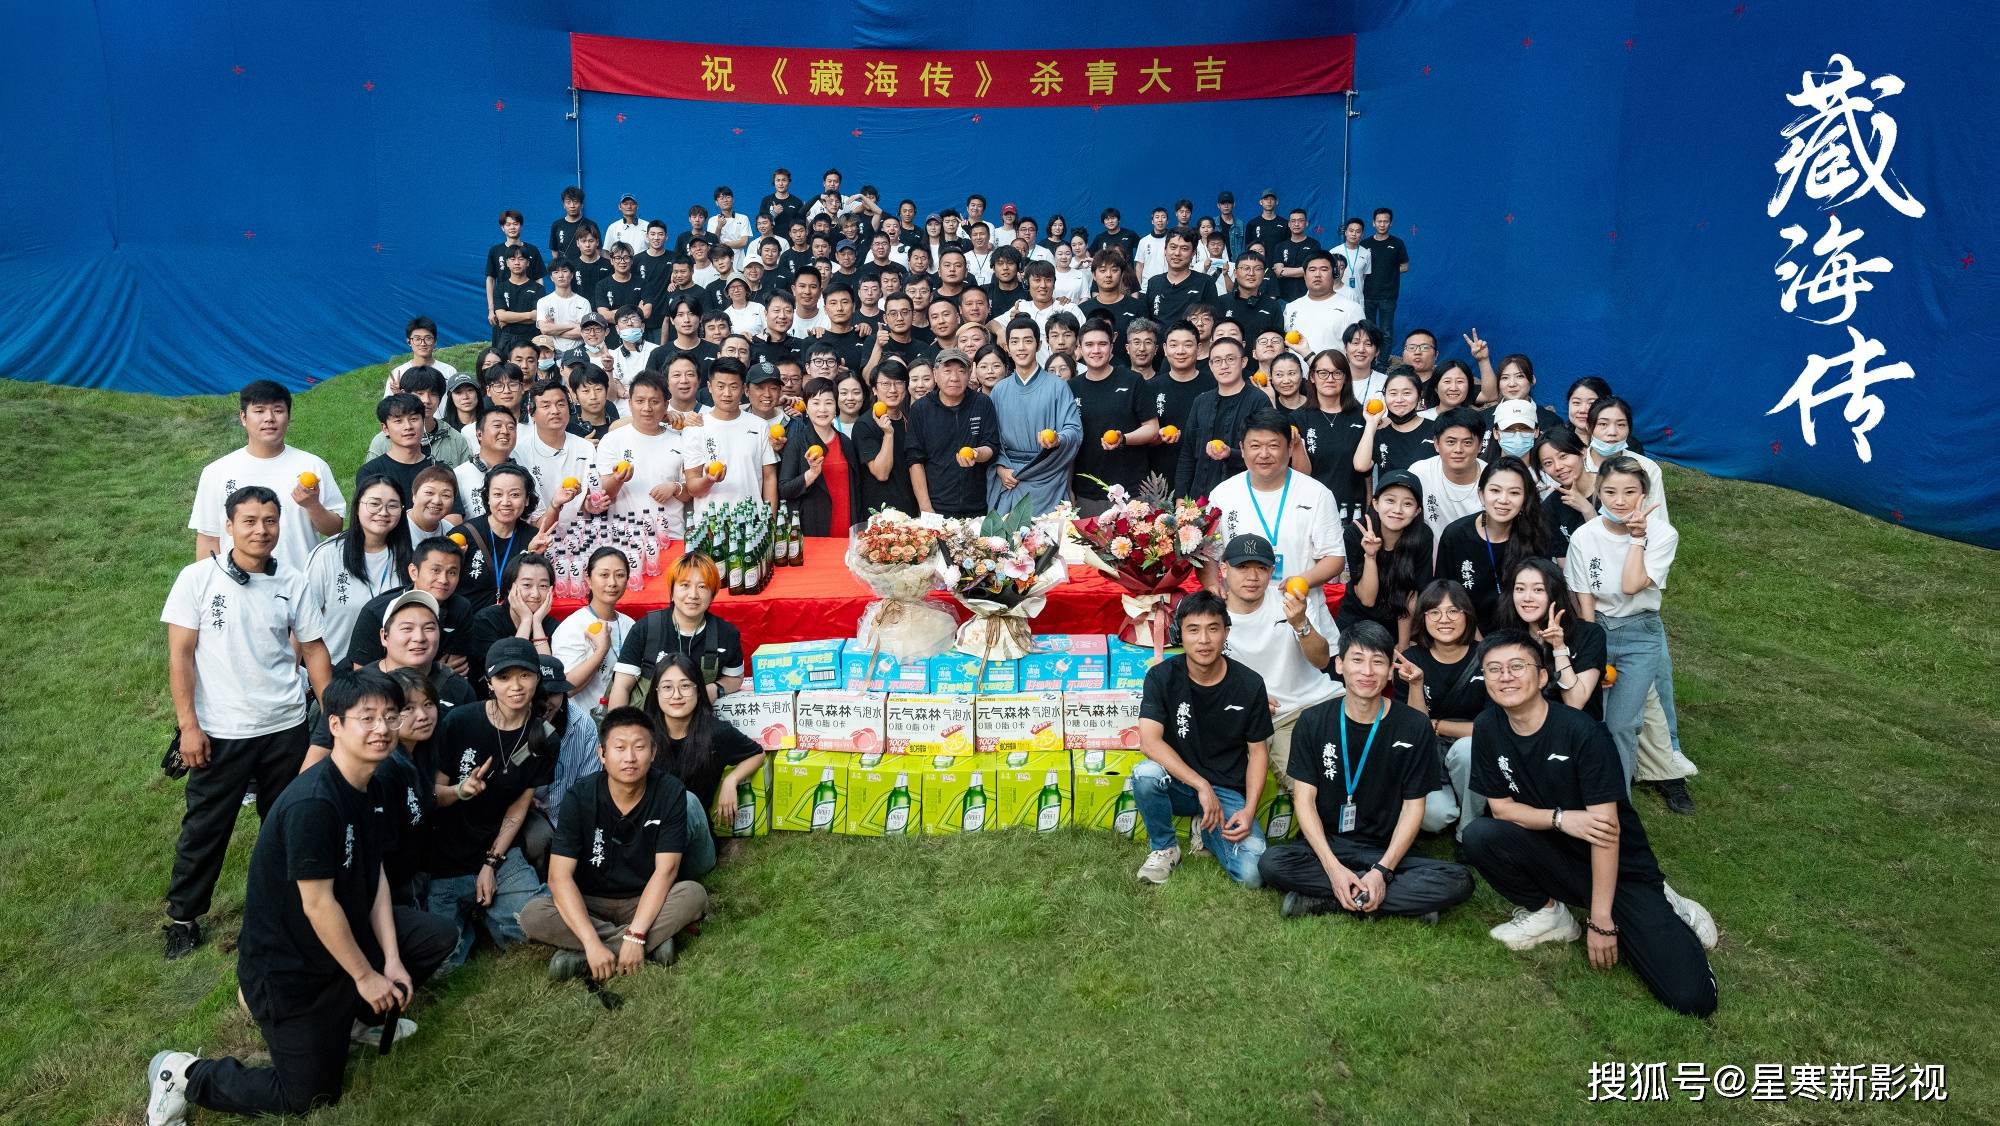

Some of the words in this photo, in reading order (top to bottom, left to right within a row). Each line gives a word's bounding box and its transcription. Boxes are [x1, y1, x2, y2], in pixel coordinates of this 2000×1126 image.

[701, 54, 1227, 98] 祝《藏海传》杀青大吉
[762, 701, 791, 714] 气泡水
[799, 704, 852, 718] 元气森林
[853, 705, 882, 719] 气泡水
[889, 707, 941, 721] 元气森林
[943, 708, 972, 722] 气泡水
[977, 706, 1031, 720] 元气森林
[1032, 706, 1061, 718] 气泡水
[1066, 704, 1119, 717] 元气森林
[1120, 704, 1140, 718] 气泡
[1176, 701, 1190, 739] 藏海传
[1322, 742, 1338, 781] 藏海传
